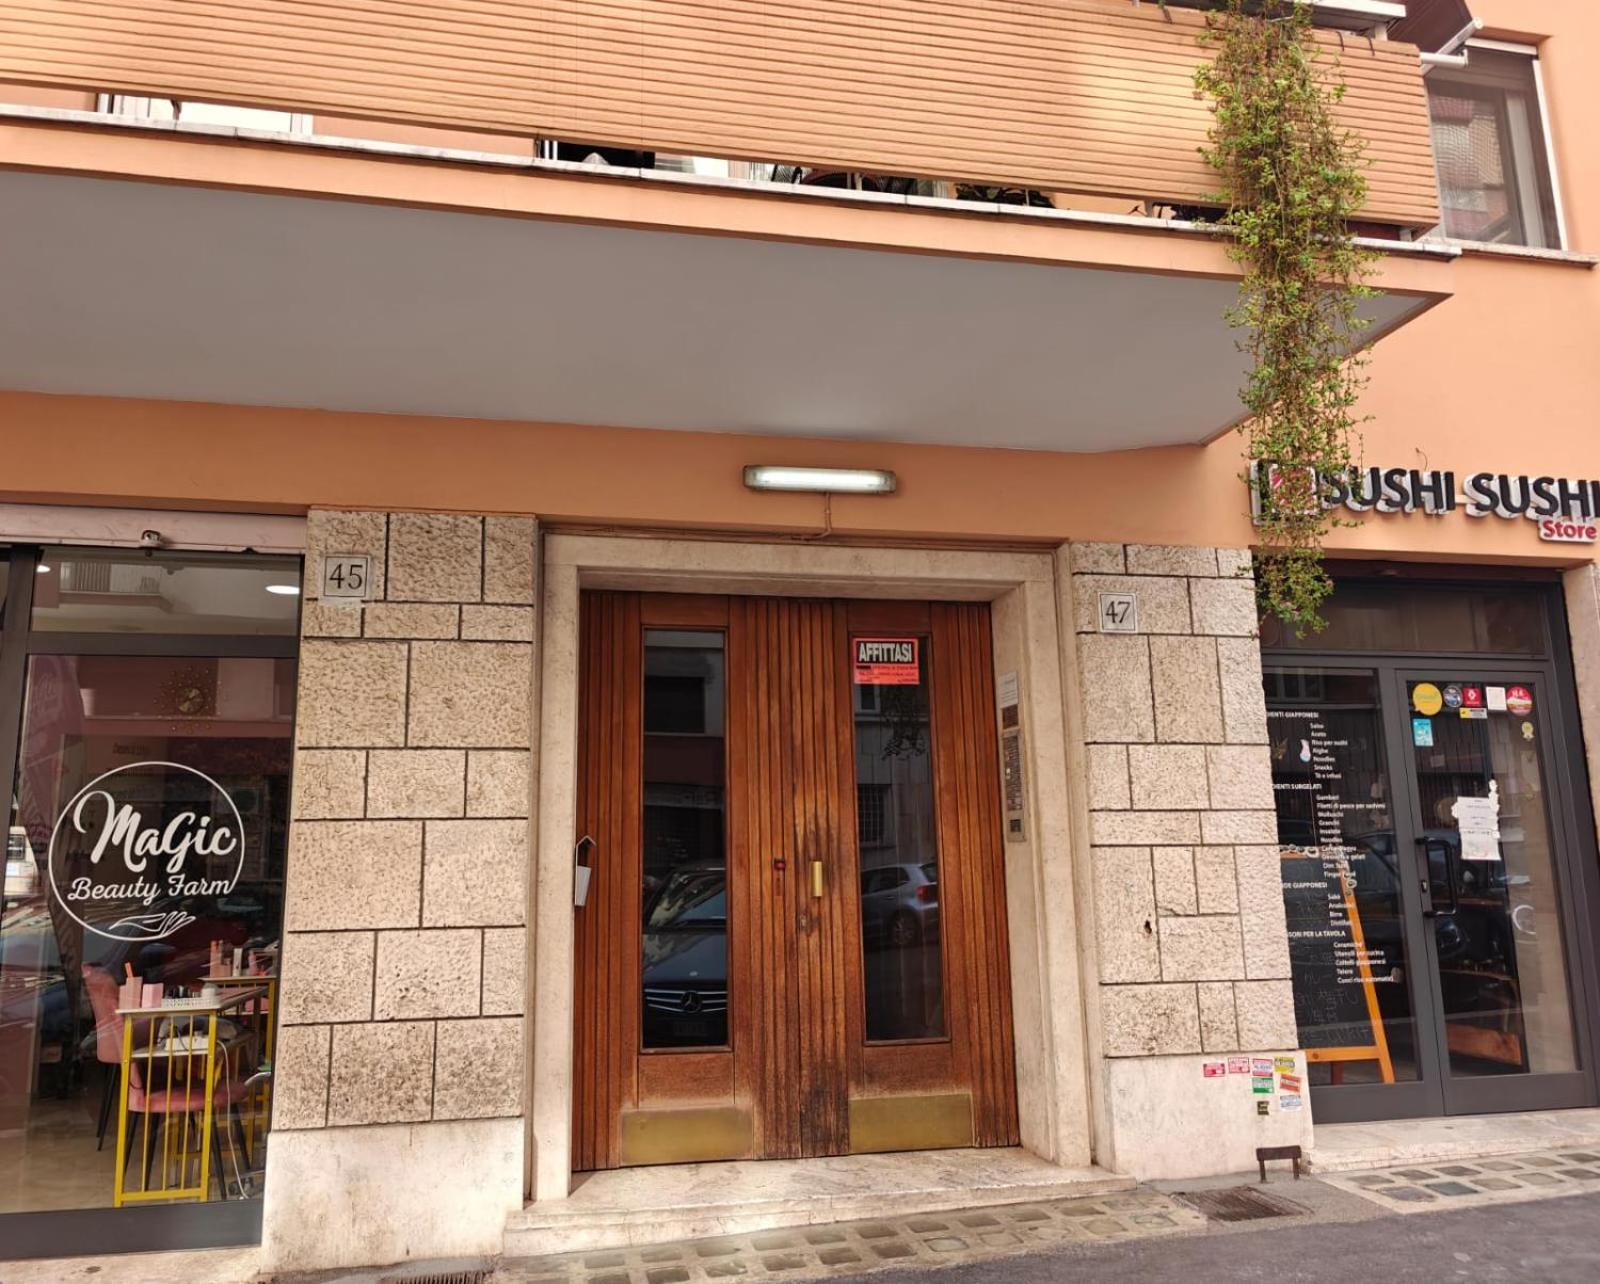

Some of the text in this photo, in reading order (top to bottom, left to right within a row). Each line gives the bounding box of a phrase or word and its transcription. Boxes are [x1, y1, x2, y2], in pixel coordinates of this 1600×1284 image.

[1319, 466, 1600, 519] SUSHI SUSHI
[1541, 519, 1598, 541] Store
[328, 562, 363, 590] 45
[1105, 600, 1131, 624] 47
[858, 642, 913, 663] AFFITTASI
[67, 873, 233, 906] Beauty Farm
[1292, 881, 1328, 889] GIAPPONESI
[1323, 929, 1346, 937] TAVOLA
